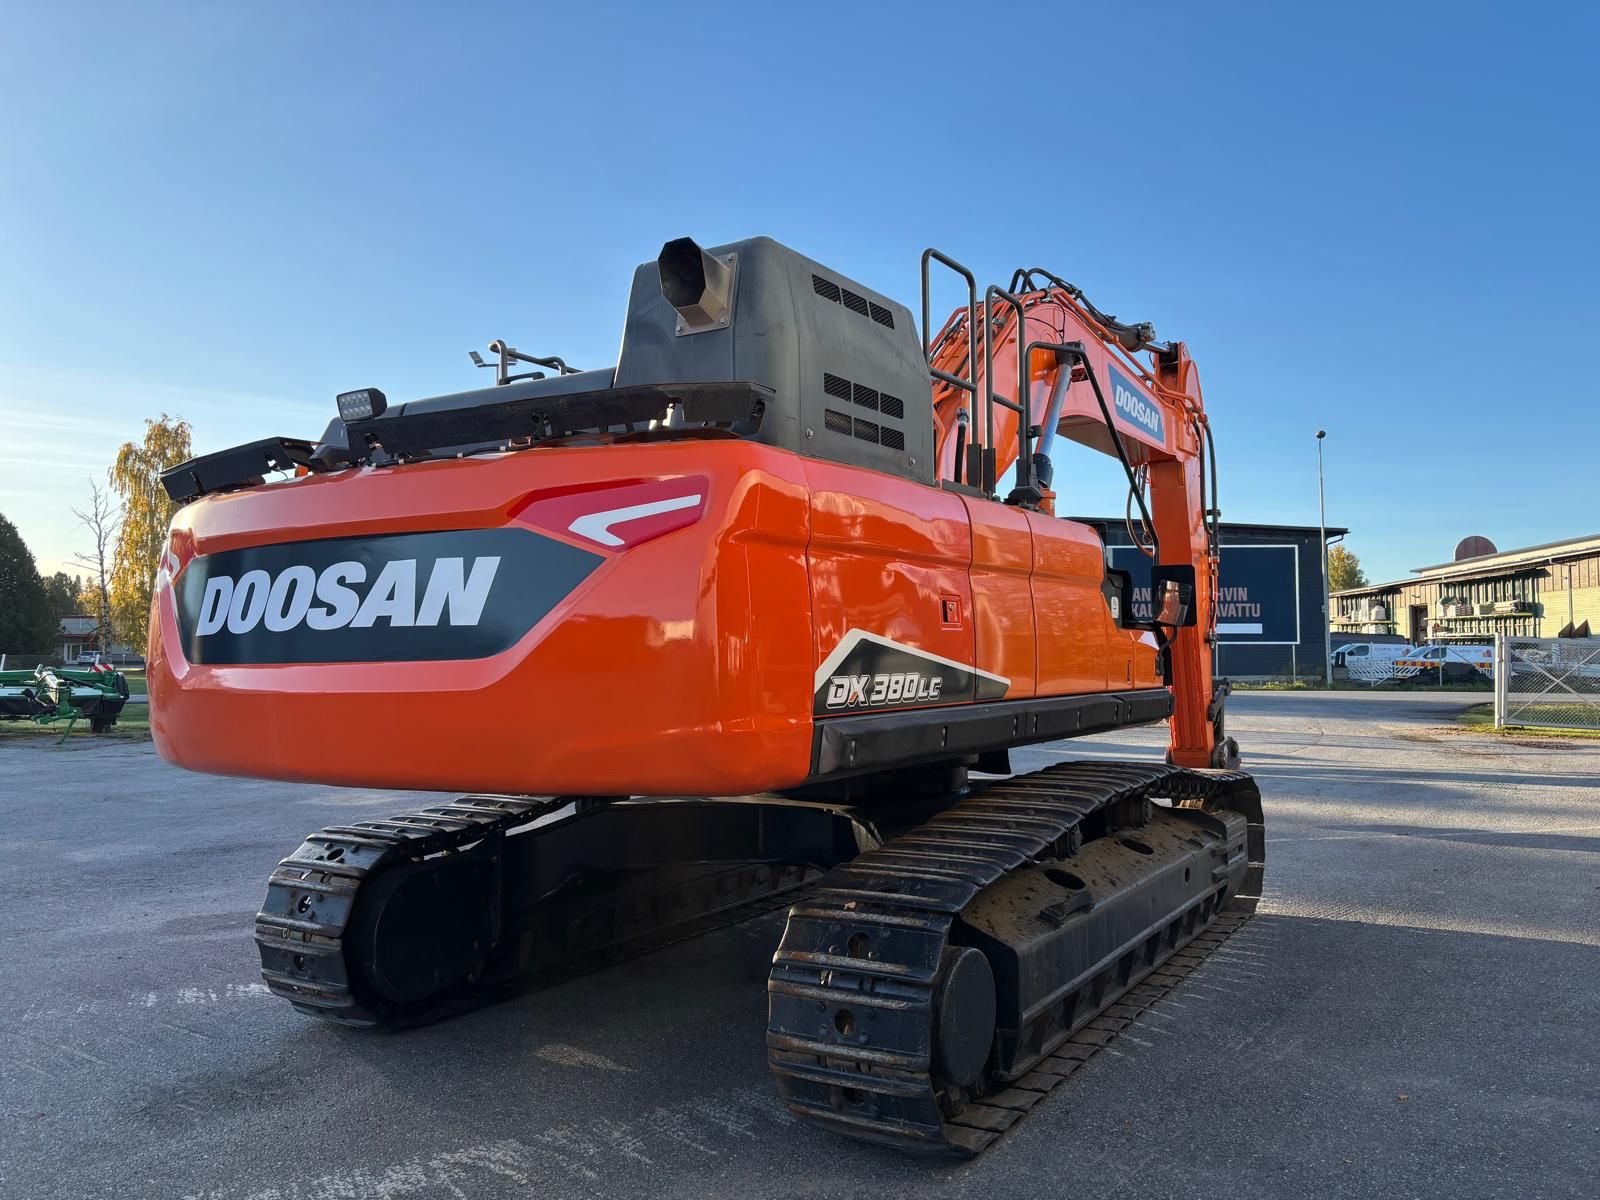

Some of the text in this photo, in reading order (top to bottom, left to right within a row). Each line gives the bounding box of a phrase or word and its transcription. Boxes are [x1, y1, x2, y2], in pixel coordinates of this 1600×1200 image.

[1115, 384, 1159, 432] DOOSAN
[196, 556, 501, 636] DOOSAN
[826, 675, 870, 709] DX
